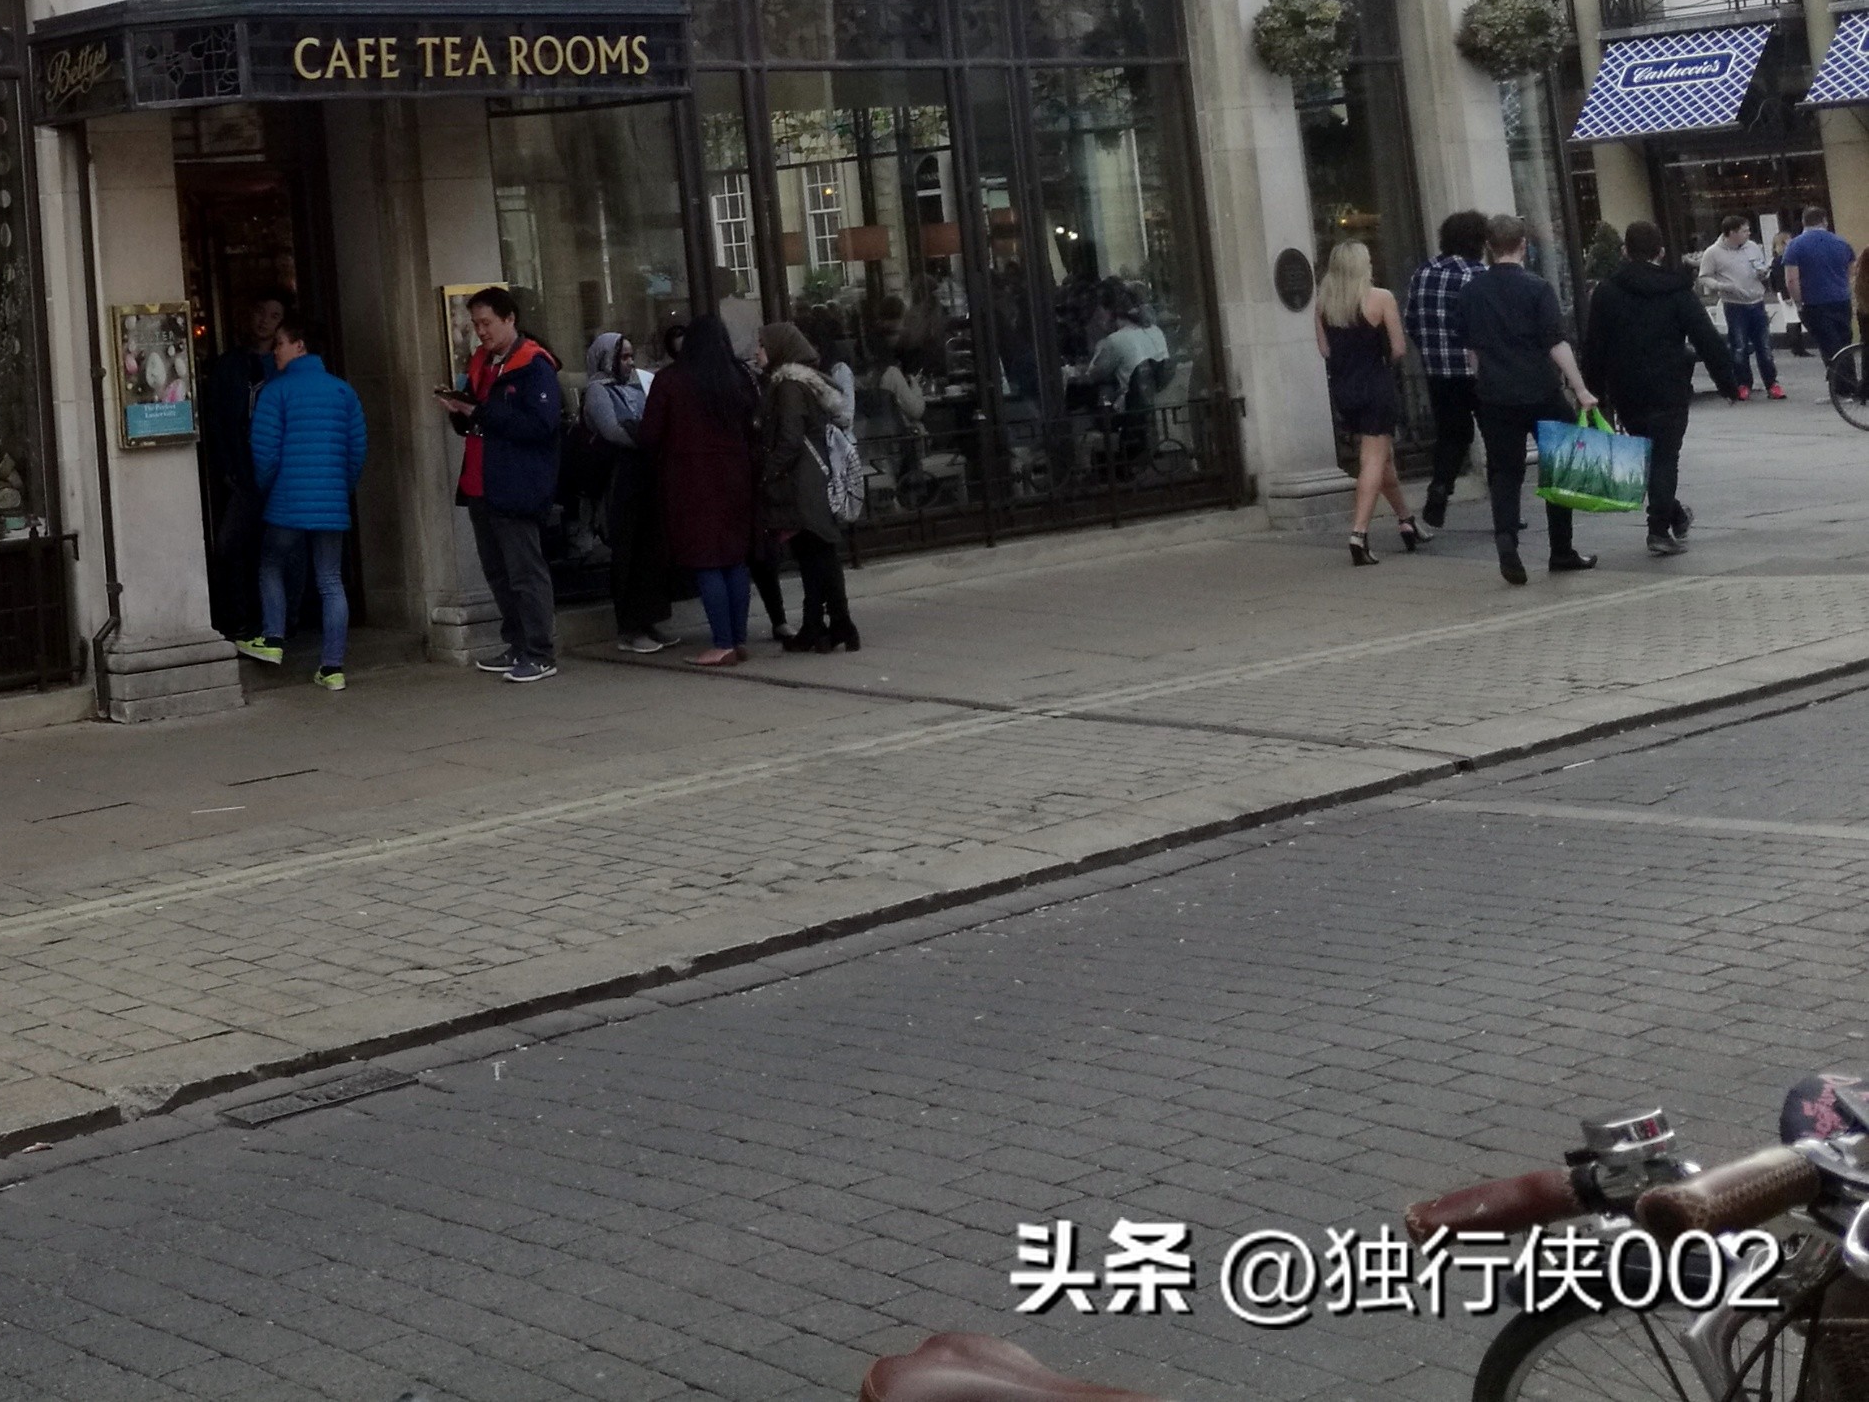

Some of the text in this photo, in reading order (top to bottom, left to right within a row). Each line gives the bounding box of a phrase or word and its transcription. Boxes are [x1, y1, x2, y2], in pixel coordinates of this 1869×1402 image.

[45, 40, 108, 102] Bettys
[293, 34, 650, 79] CAFE TEA ROOMS
[1632, 59, 1721, 83] Carluccio's
